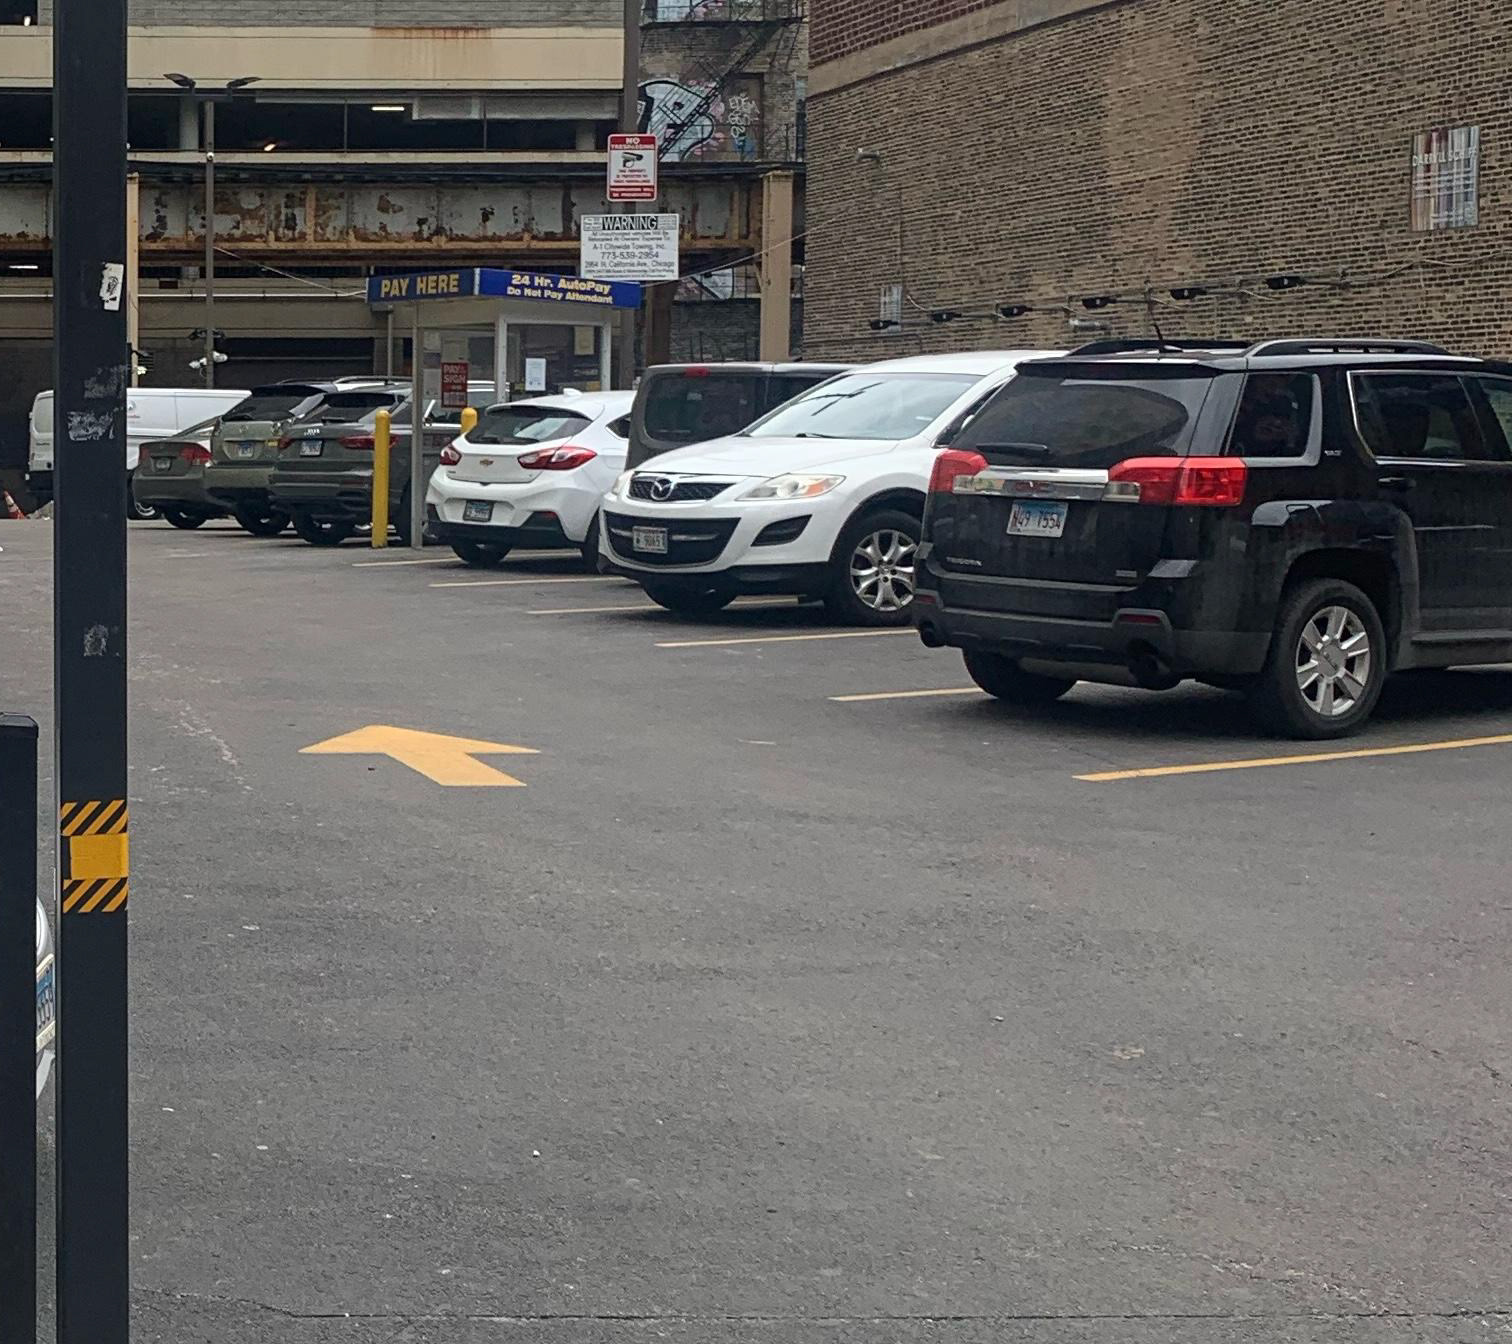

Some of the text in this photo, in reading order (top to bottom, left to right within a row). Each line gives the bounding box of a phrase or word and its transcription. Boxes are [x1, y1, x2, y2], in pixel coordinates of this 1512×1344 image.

[625, 137, 640, 145] NO
[603, 216, 658, 230] WARNING
[380, 273, 460, 298] PAY HERE
[511, 274, 611, 295] 24 Hr. AutoPay
[506, 286, 613, 305] Do Not Pay Attendant
